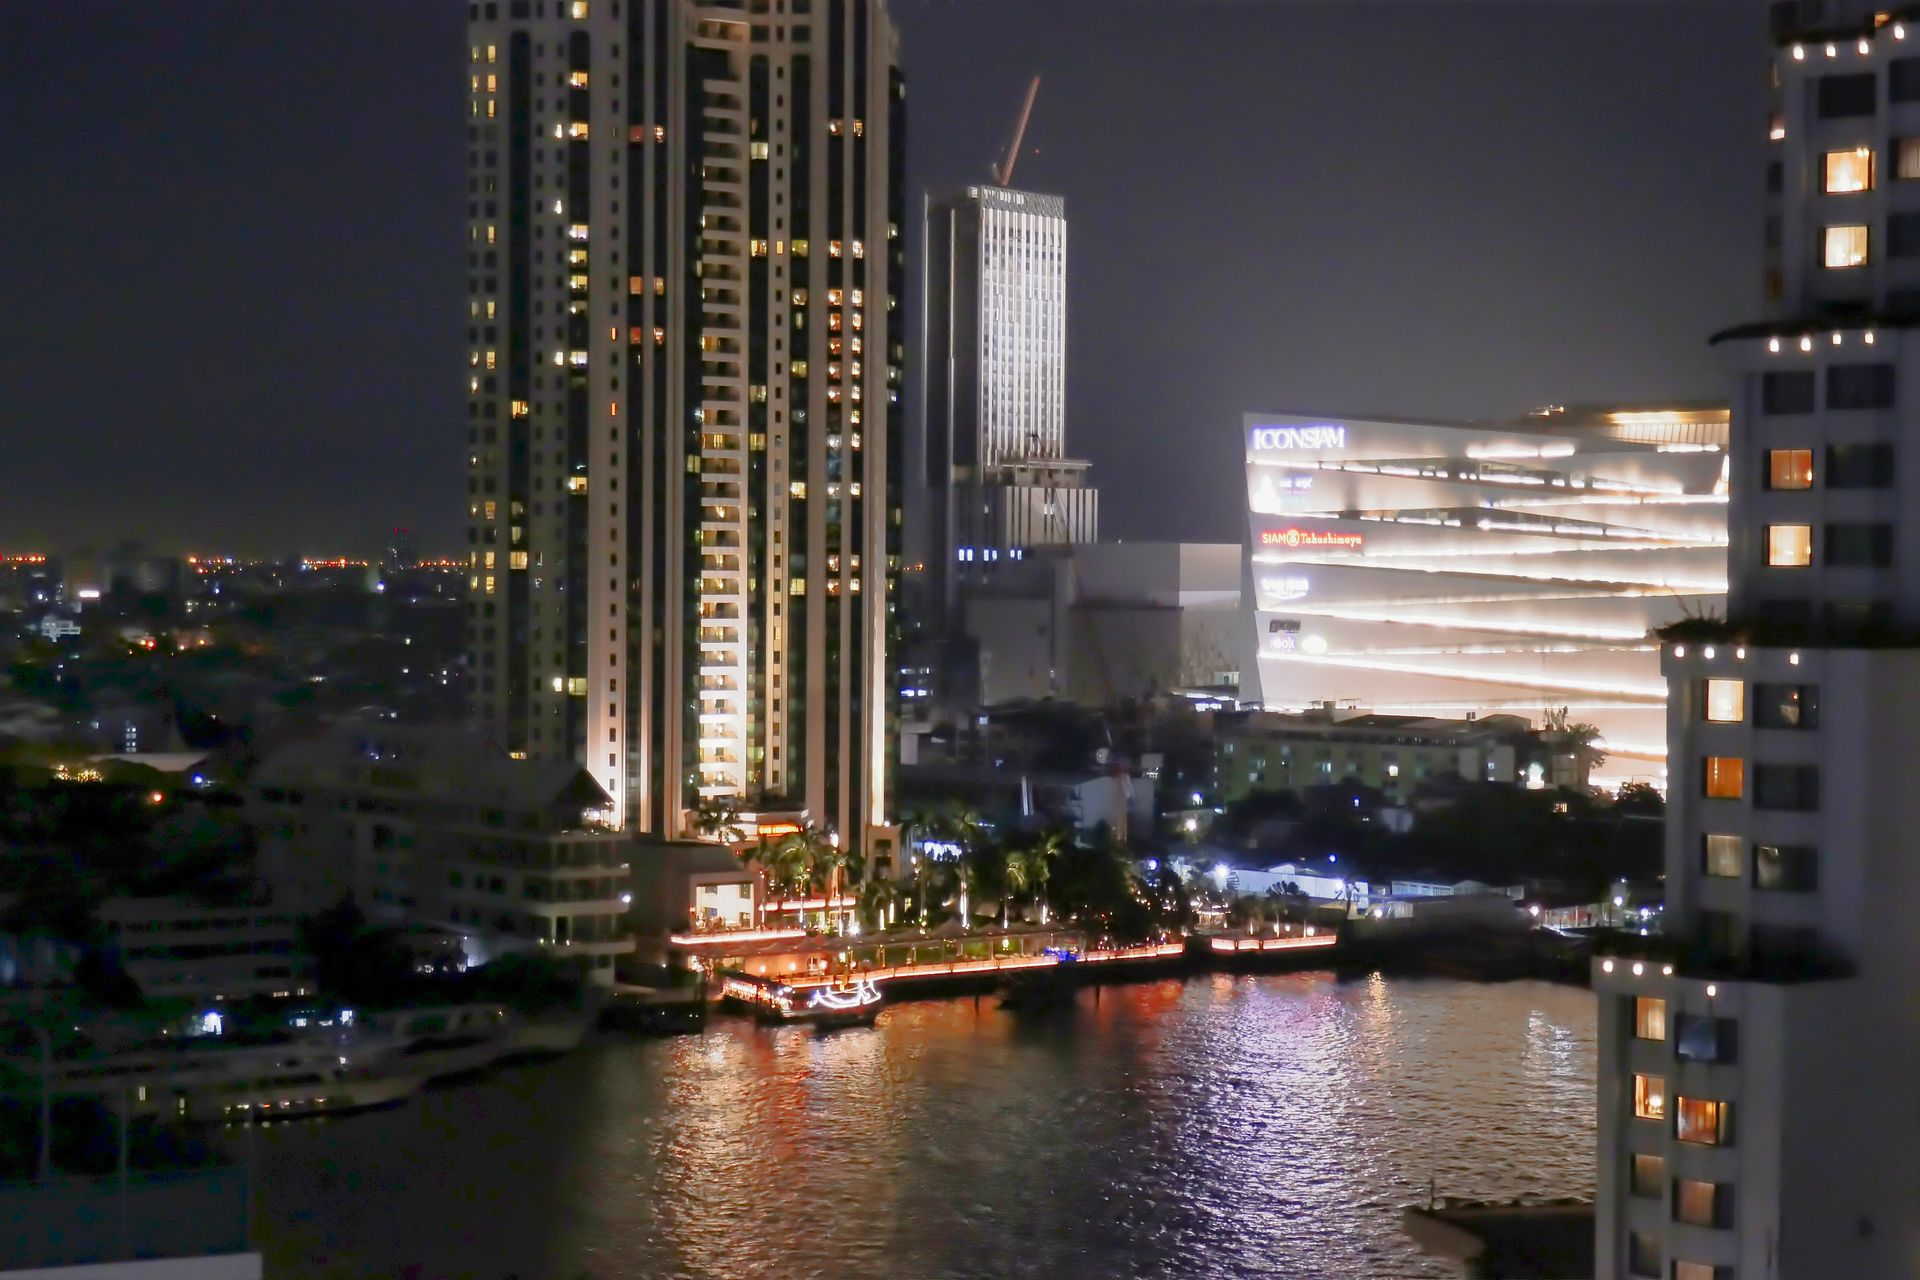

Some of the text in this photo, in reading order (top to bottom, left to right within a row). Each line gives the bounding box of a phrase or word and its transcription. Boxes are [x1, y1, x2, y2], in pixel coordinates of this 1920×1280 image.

[1253, 427, 1345, 449] ICONSIAM
[1262, 532, 1361, 547] SIAM Takashimaya
